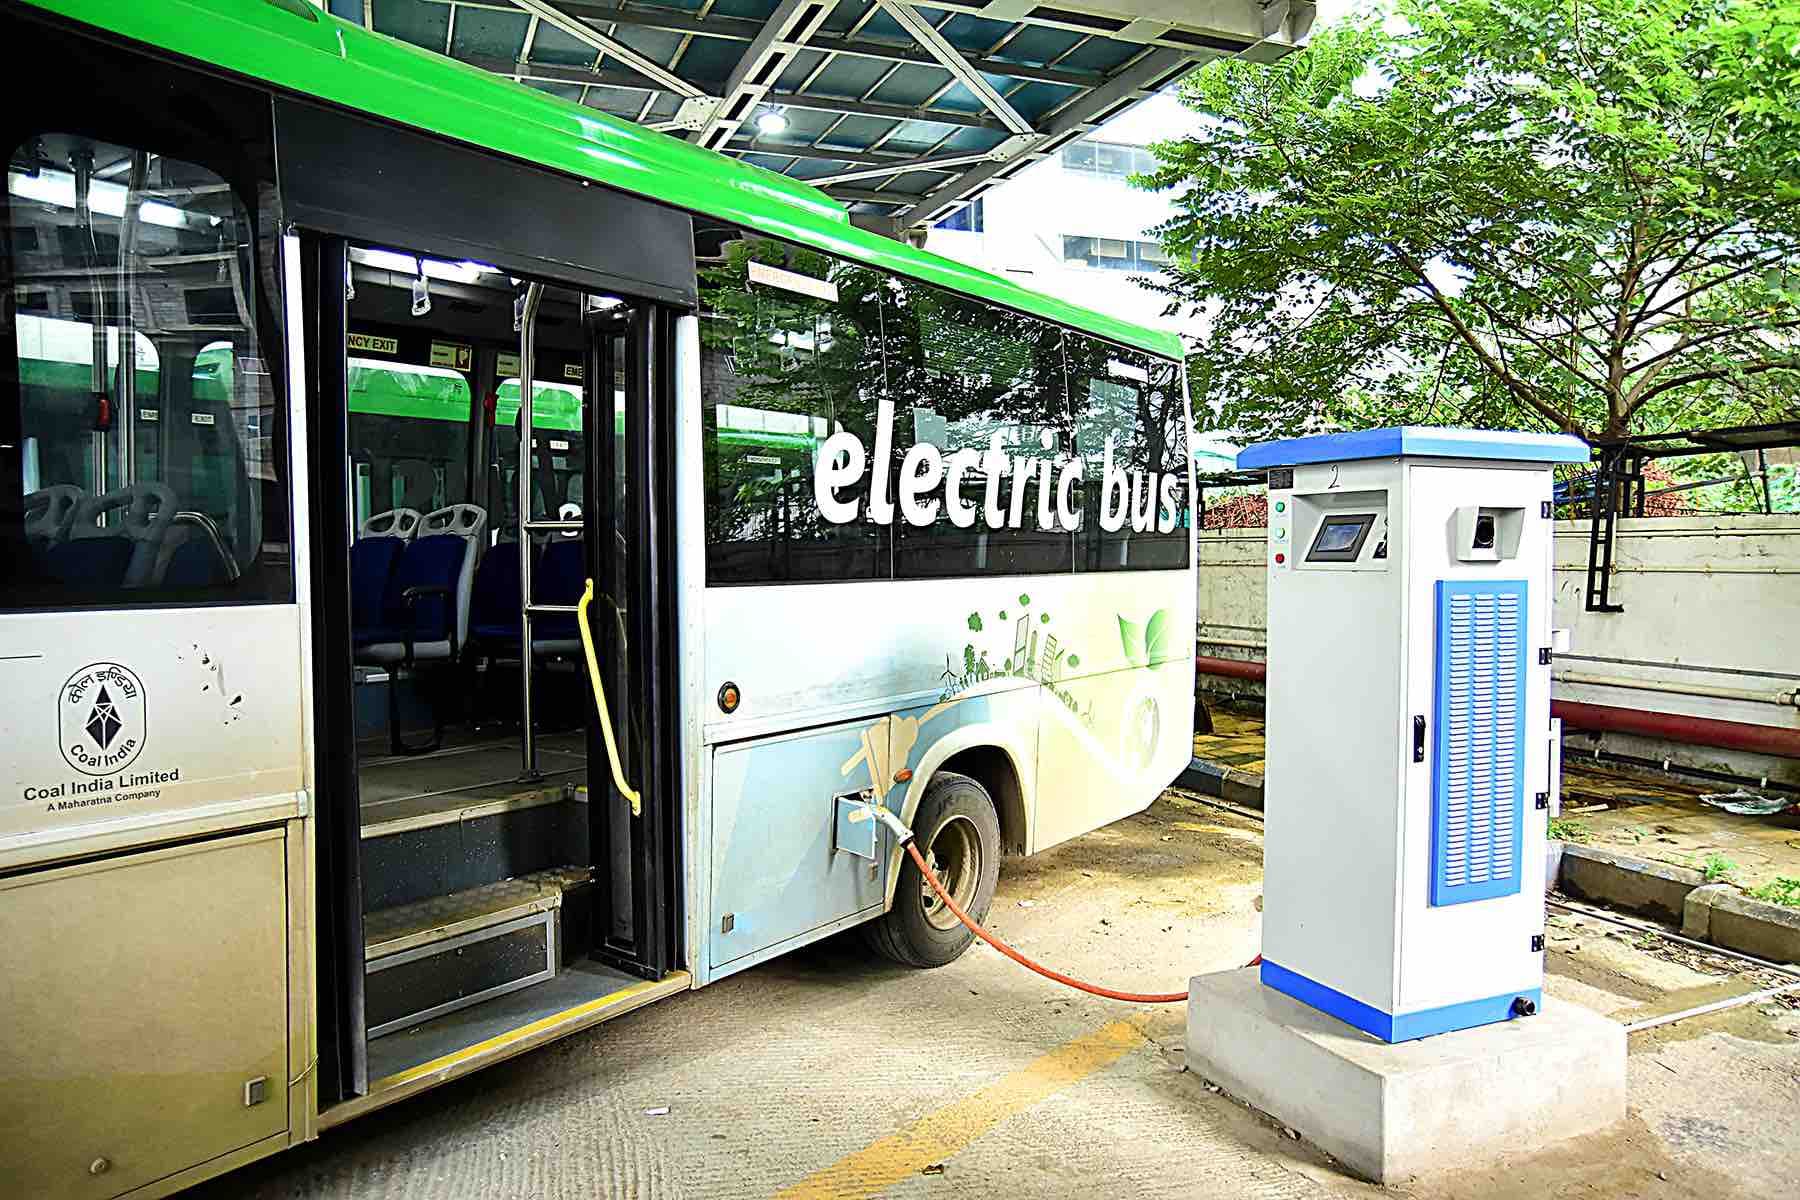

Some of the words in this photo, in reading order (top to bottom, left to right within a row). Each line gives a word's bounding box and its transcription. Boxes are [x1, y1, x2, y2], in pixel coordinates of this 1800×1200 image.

[372, 339, 396, 352] EXIT
[814, 400, 1083, 529] electric
[1099, 436, 1182, 534] bus
[1328, 465, 1341, 489] 2
[67, 674, 95, 703] कोल
[95, 666, 137, 699] इण्डिया
[70, 744, 101, 767] Coal
[104, 739, 137, 767] India
[23, 783, 65, 801] Coal
[71, 778, 113, 795] India
[119, 768, 179, 788] Limited
[47, 803, 55, 812] A
[57, 795, 112, 811] Maharatna
[114, 789, 161, 803] Company
